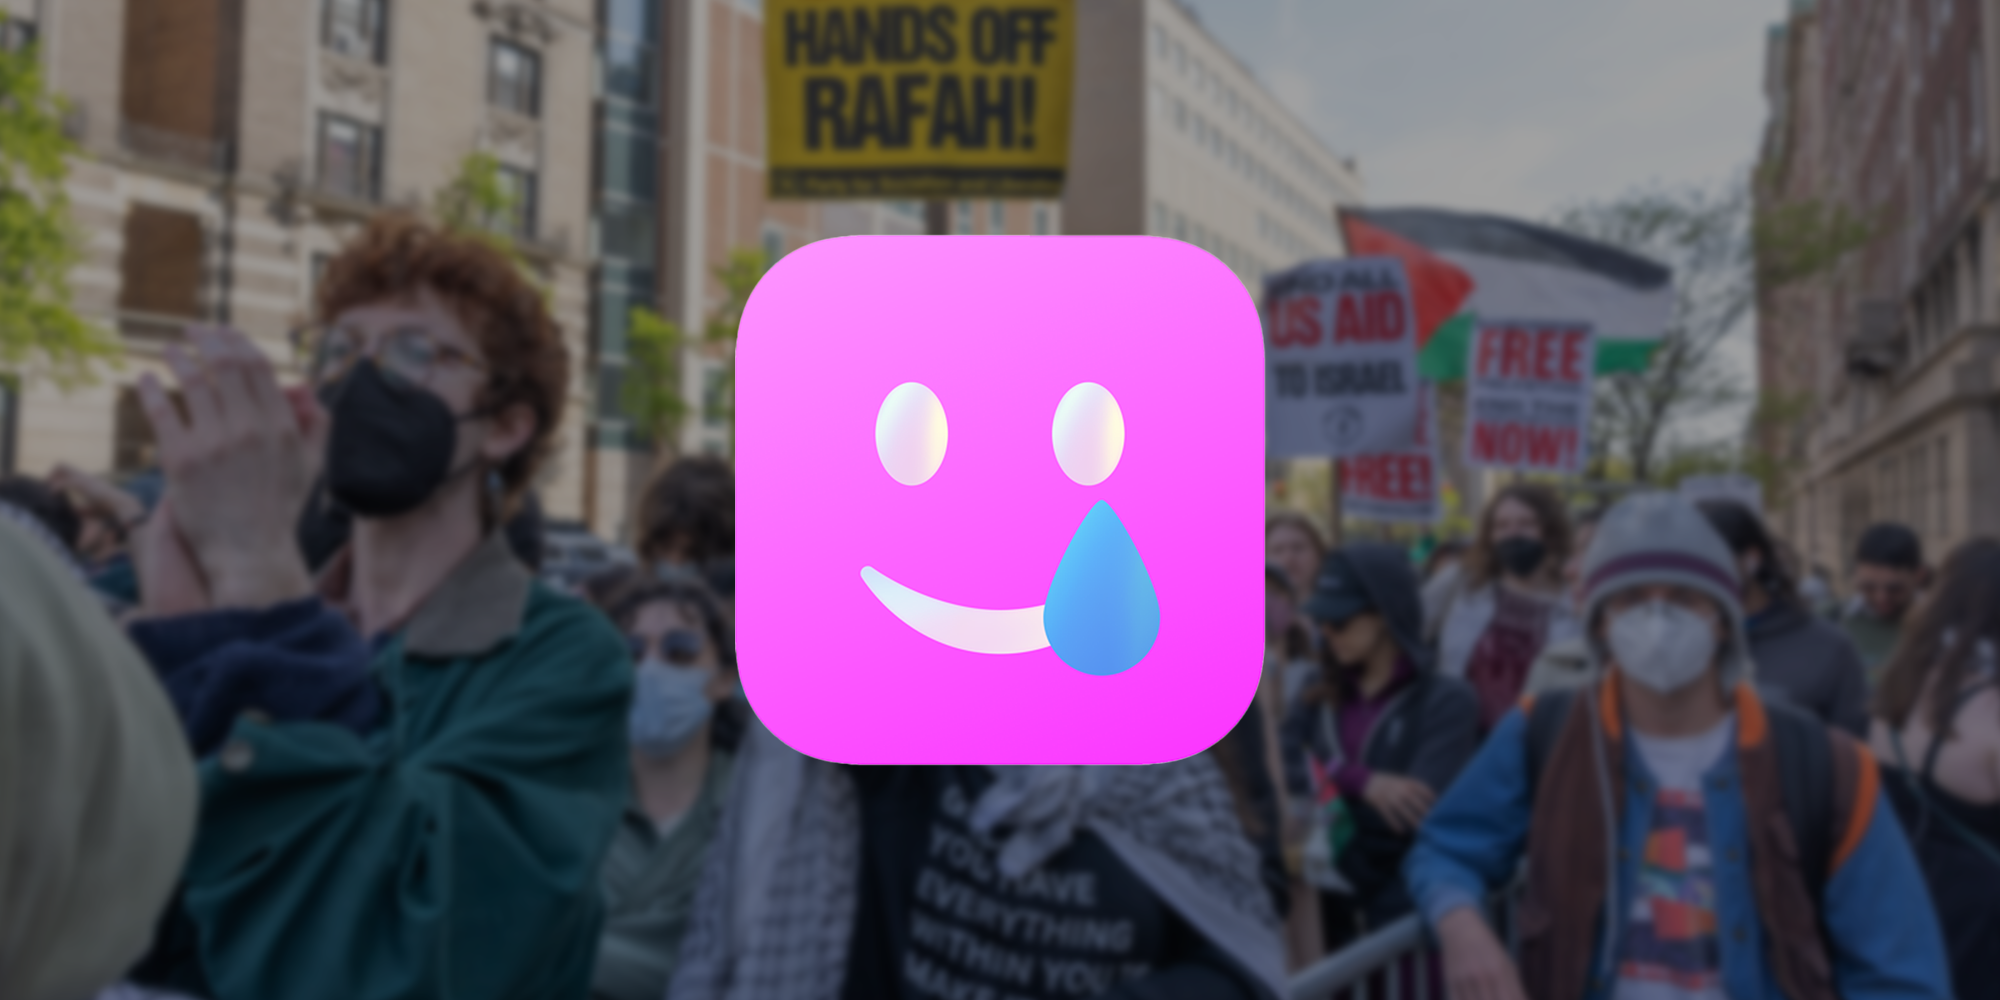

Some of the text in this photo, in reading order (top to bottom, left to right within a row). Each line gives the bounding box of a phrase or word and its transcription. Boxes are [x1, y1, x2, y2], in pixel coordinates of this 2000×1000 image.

[785, 7, 1058, 66] HANDS OFF
[805, 74, 1036, 151] RAFAH!
[1269, 291, 1406, 349] US AID
[1275, 360, 1408, 398] TO ISRAEL
[1476, 328, 1586, 382] FREE
[1472, 420, 1579, 470] NOW!
[1340, 452, 1432, 500] FREE!
[915, 865, 1134, 954] EVERYTHING
[909, 907, 1035, 987] WITHIN
